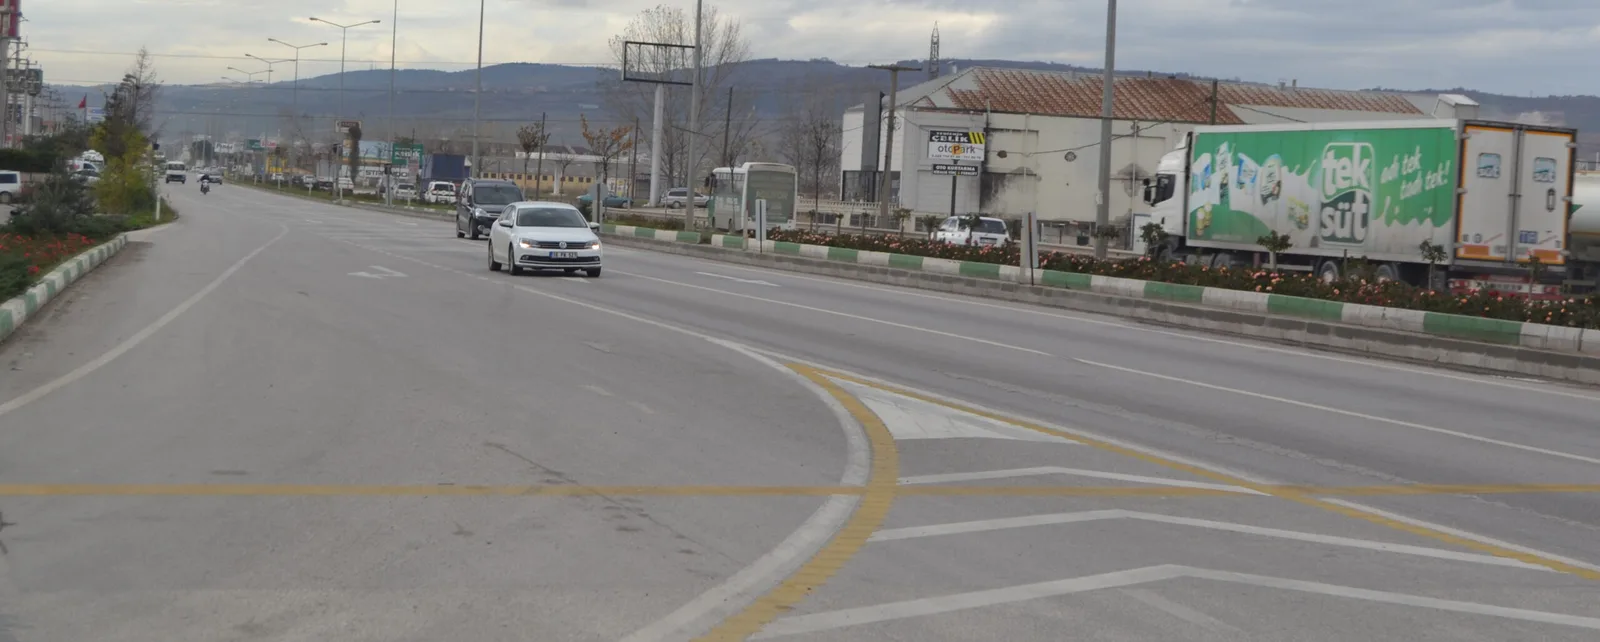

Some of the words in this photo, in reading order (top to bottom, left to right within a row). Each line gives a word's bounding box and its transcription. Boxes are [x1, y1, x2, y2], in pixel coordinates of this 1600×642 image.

[1322, 144, 1370, 195] tek
[1401, 145, 1422, 176] tek
[1321, 190, 1368, 241] süt
